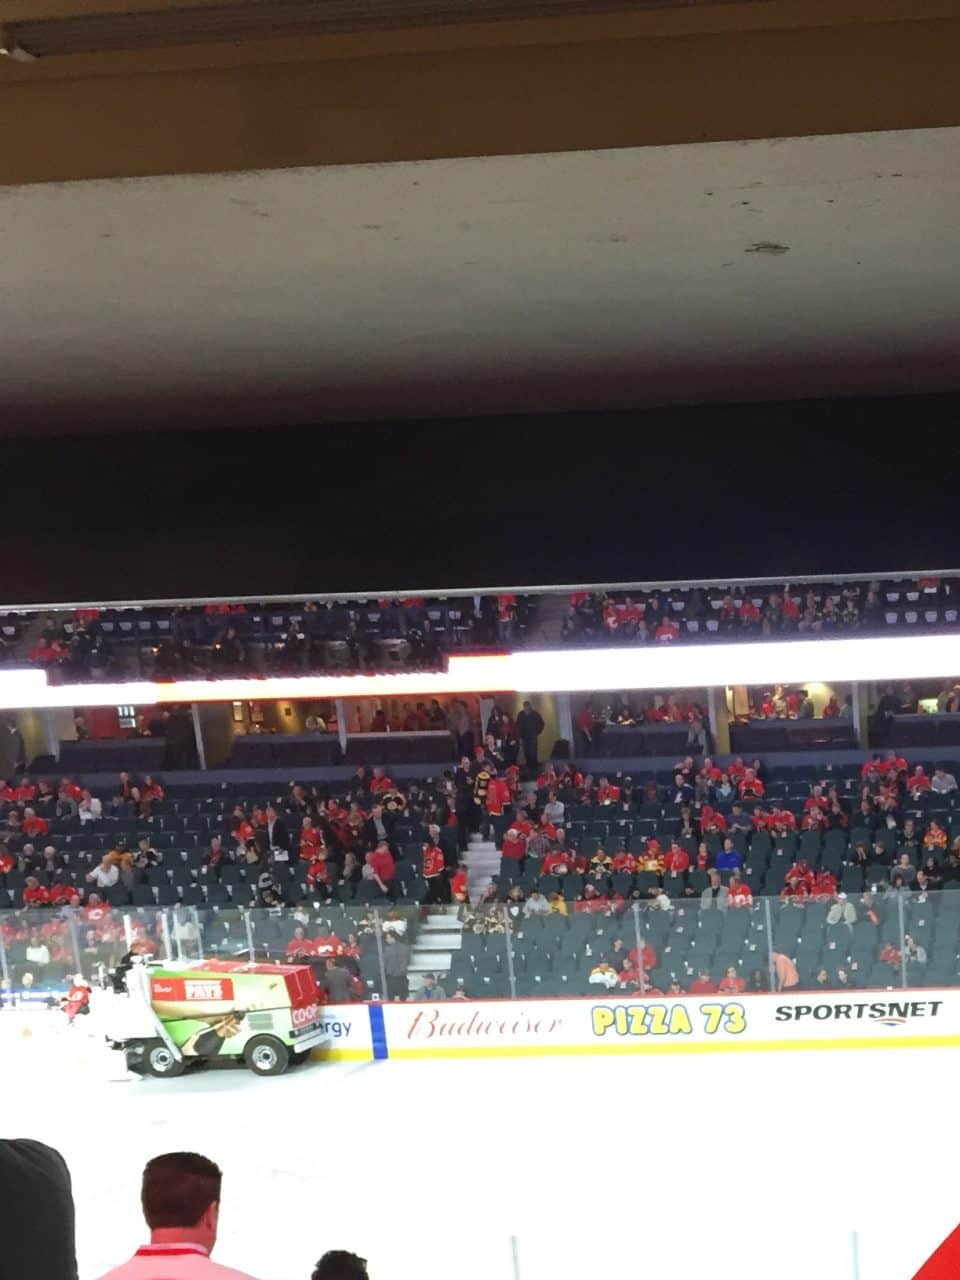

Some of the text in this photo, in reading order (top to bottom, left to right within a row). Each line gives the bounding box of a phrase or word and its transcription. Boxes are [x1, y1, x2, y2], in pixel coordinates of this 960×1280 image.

[407, 1009, 563, 1039] Budweiser
[591, 1002, 747, 1036] PIZZA 73
[775, 1001, 943, 1021] SPORTSNET
